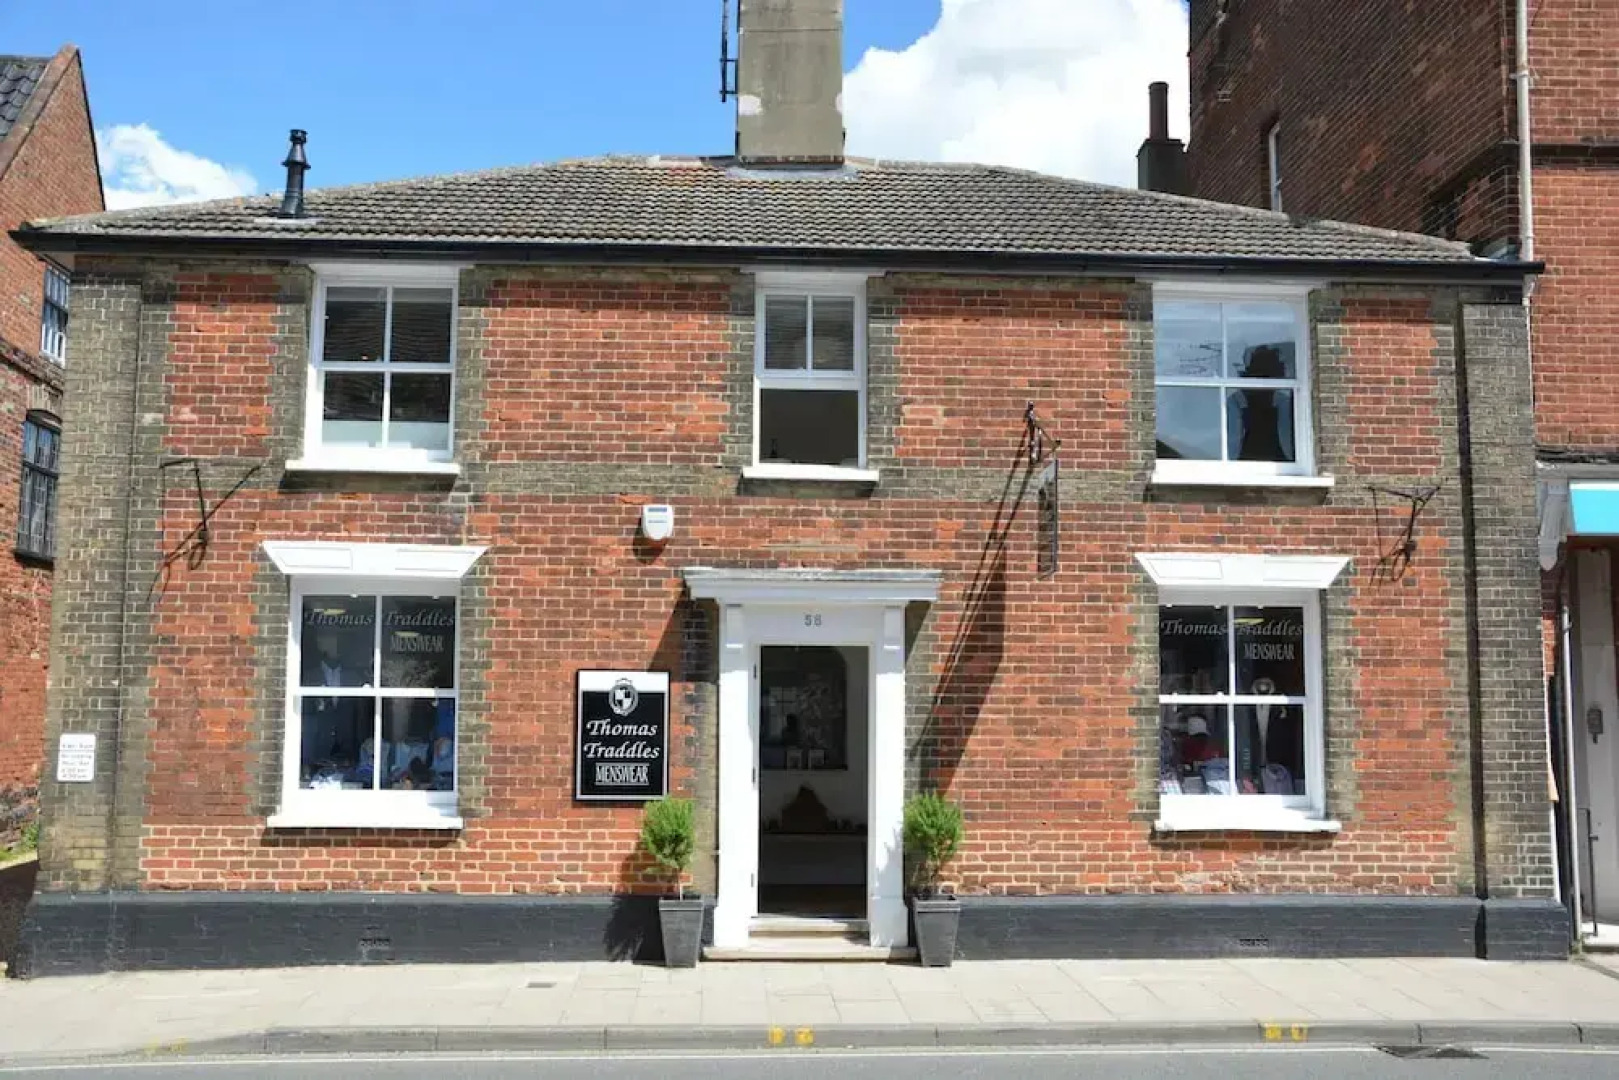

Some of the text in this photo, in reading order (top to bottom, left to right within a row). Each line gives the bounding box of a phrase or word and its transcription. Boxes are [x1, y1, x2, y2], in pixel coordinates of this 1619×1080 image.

[305, 609, 455, 626] Thomas Traddles
[1160, 618, 1303, 636] Thomas Traddles
[390, 634, 444, 652] MENSWEAR
[1244, 643, 1295, 660] MENSWEAR
[585, 718, 658, 736] Thomas
[583, 741, 660, 759] Traddles
[595, 764, 649, 784] MENSWEAR
